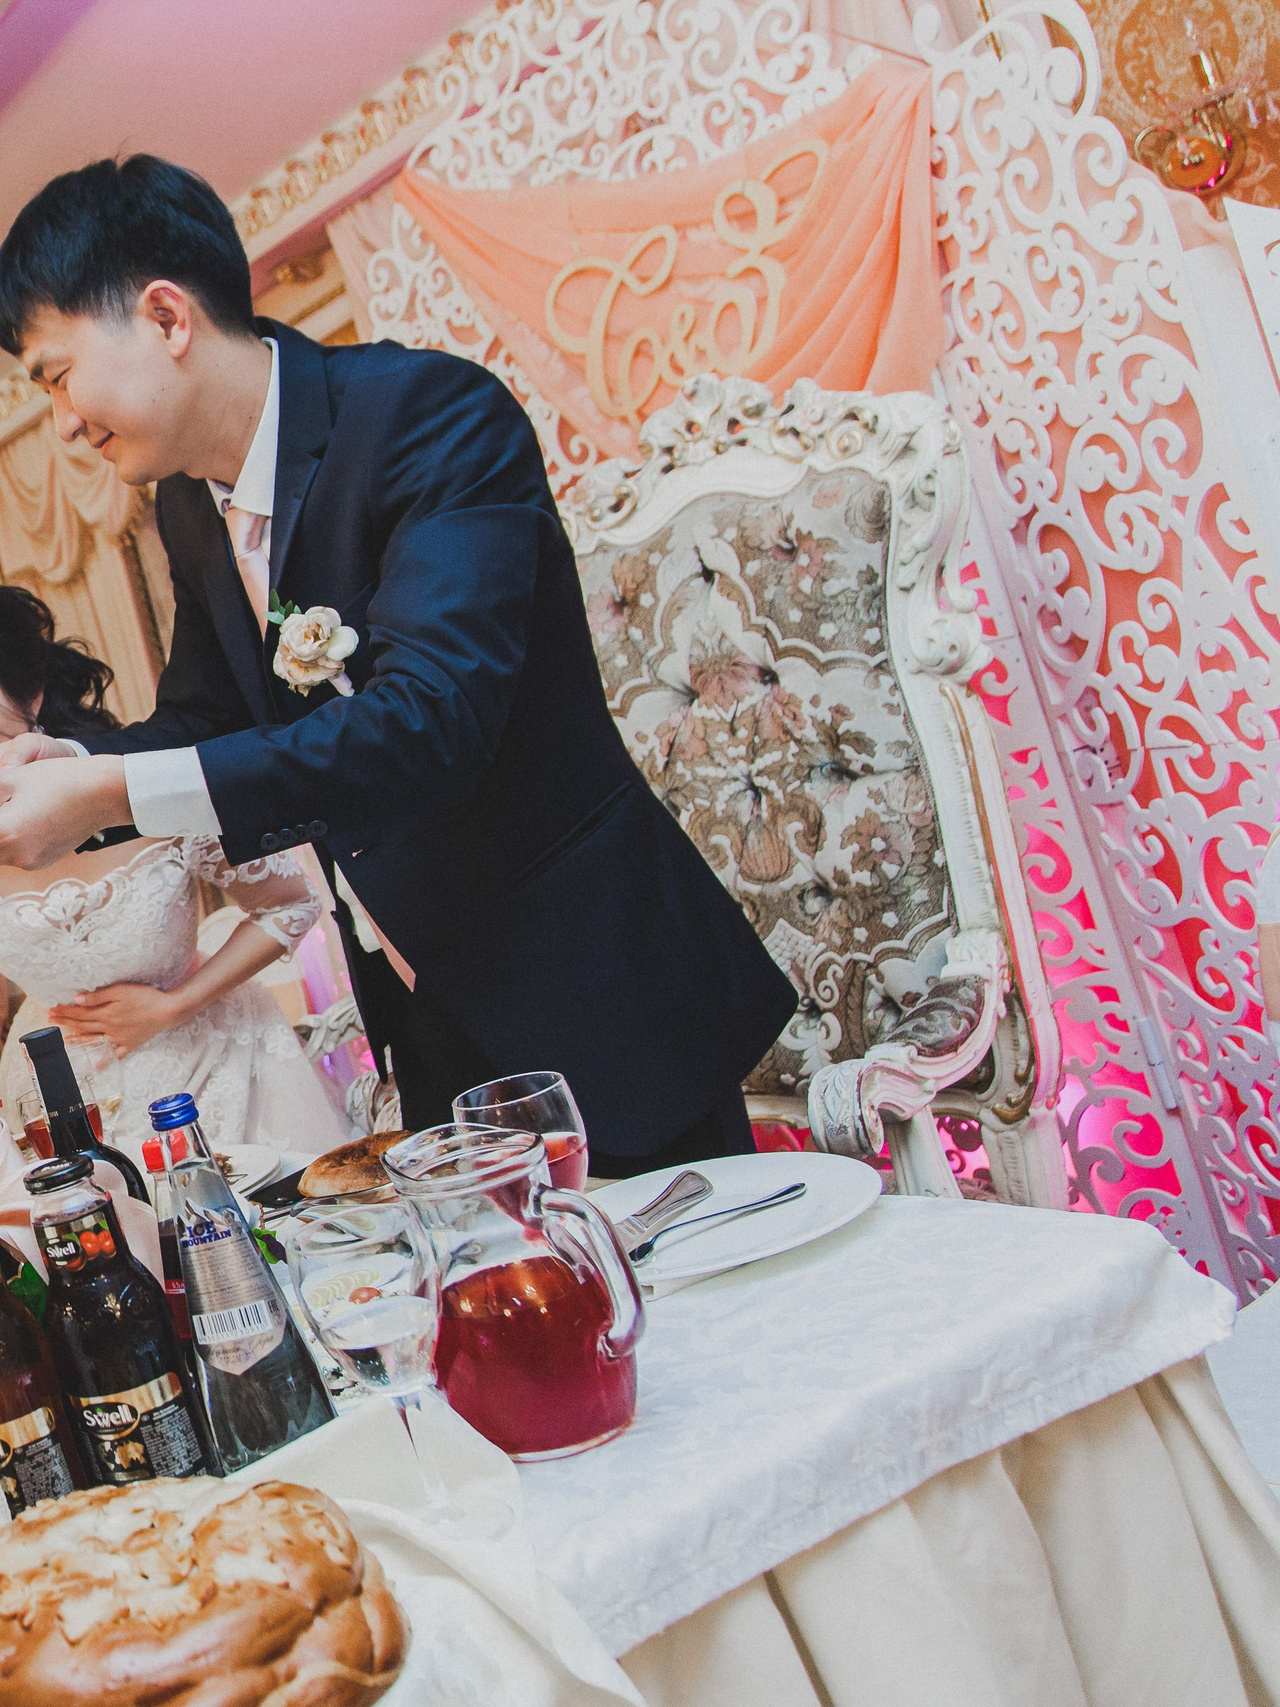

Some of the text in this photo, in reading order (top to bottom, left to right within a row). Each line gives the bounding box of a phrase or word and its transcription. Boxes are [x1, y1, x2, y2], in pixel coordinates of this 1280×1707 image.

[186, 1220, 216, 1238] ICE
[182, 1229, 232, 1248] MOUNTAIN
[46, 1242, 76, 1258] Swell
[83, 1404, 134, 1429] Swell
